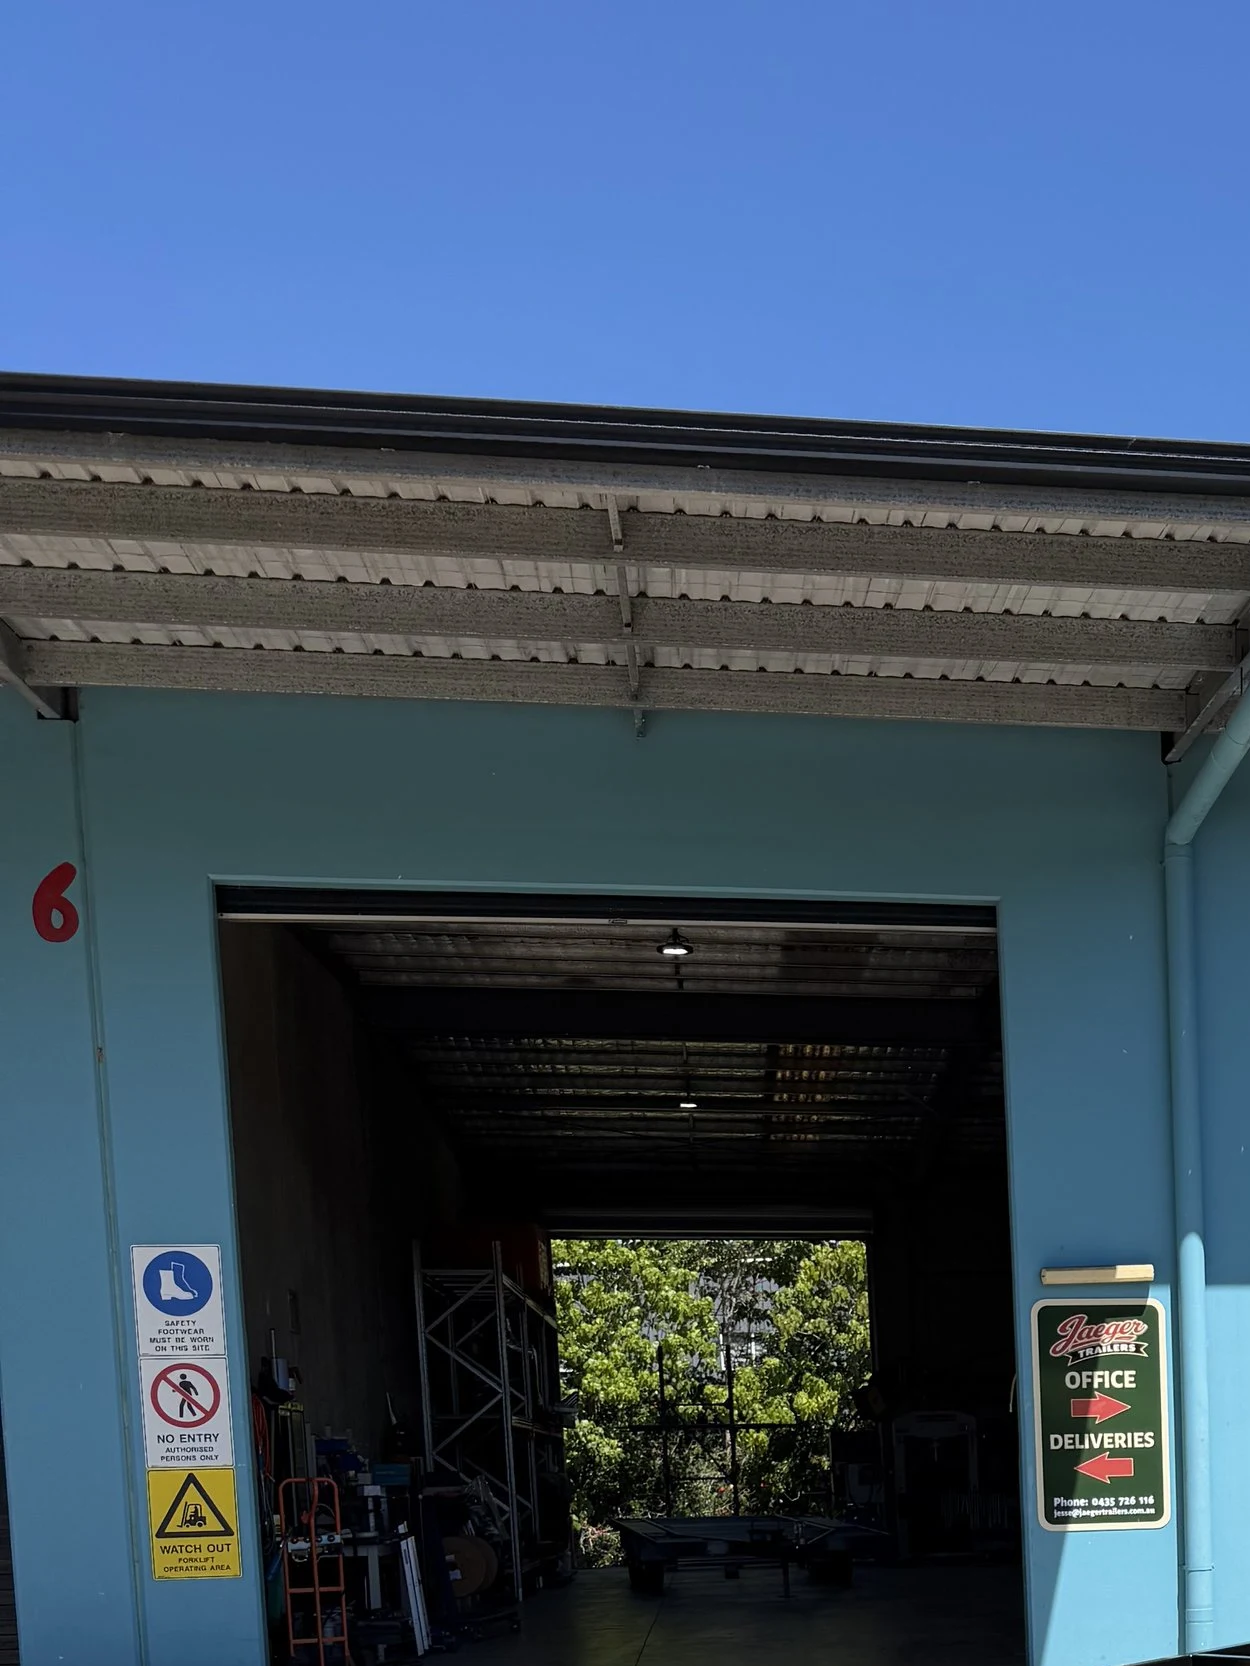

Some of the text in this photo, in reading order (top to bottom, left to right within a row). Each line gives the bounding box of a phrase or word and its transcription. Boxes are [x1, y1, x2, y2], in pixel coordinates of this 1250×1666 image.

[32, 861, 79, 943] 6
[164, 1319, 197, 1327] SAFETY
[175, 1336, 186, 1344] BE
[1050, 1314, 1148, 1357] Jaeger
[192, 1344, 210, 1352] SITE
[1077, 1343, 1136, 1358] TRAILERS
[1065, 1370, 1137, 1390] OFFICE
[157, 1433, 220, 1444] NO ENTRY
[1050, 1432, 1155, 1450] DELIVERIES
[165, 1446, 214, 1454] AUTHORISED
[1053, 1495, 1155, 1507] Phone: 0435 726 116
[160, 1543, 231, 1554] WATCH OUT
